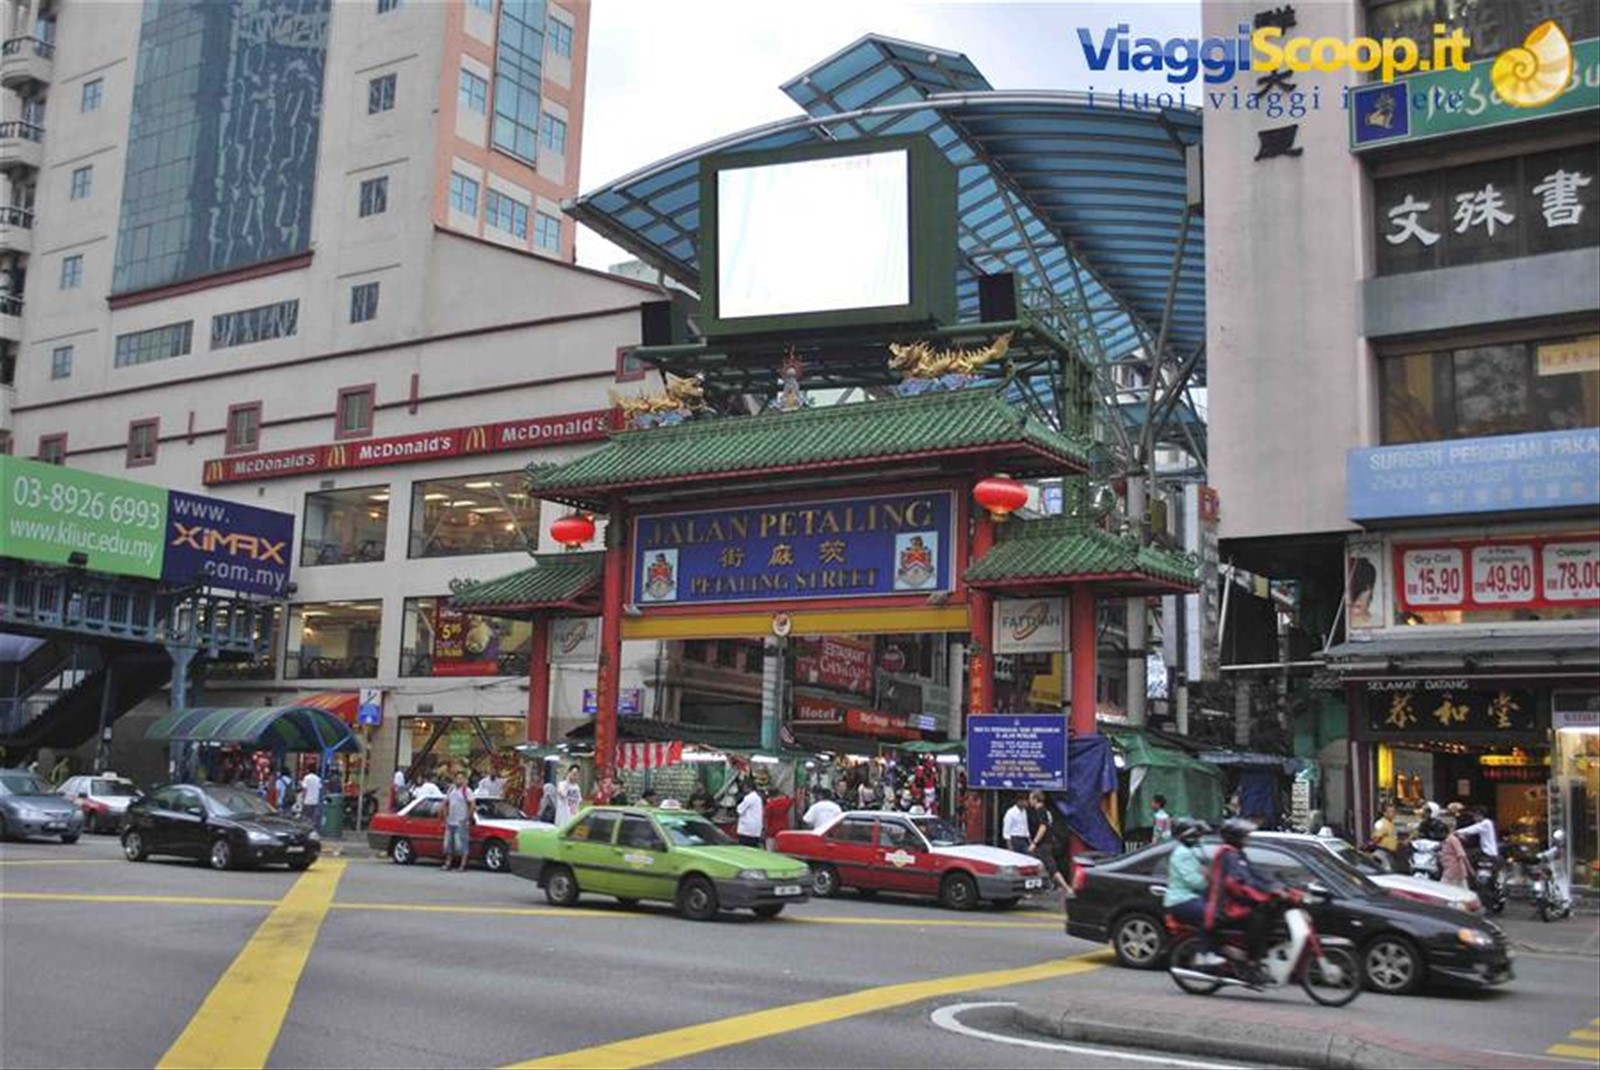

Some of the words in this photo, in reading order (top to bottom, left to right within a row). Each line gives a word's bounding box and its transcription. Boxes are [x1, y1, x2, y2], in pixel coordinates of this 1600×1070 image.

[234, 453, 315, 474] McDonald's
[359, 437, 452, 460] McDonald's
[502, 417, 608, 443] McDonald's
[13, 475, 104, 520] 03-8926
[110, 494, 161, 530] 6993
[174, 499, 231, 524] www.
[648, 516, 748, 545] JALAN
[760, 500, 932, 539] PETALING
[10, 517, 158, 565] www.kliuc.edu.my
[204, 560, 286, 590] com.my
[690, 573, 788, 595] PETALING
[795, 567, 880, 589] STREET
[1419, 567, 1461, 596] 15.90
[1487, 565, 1532, 593] 49.90
[1367, 681, 1419, 691] SELAMAT
[1425, 680, 1470, 690] DATANG
[801, 706, 837, 720] Hotel
